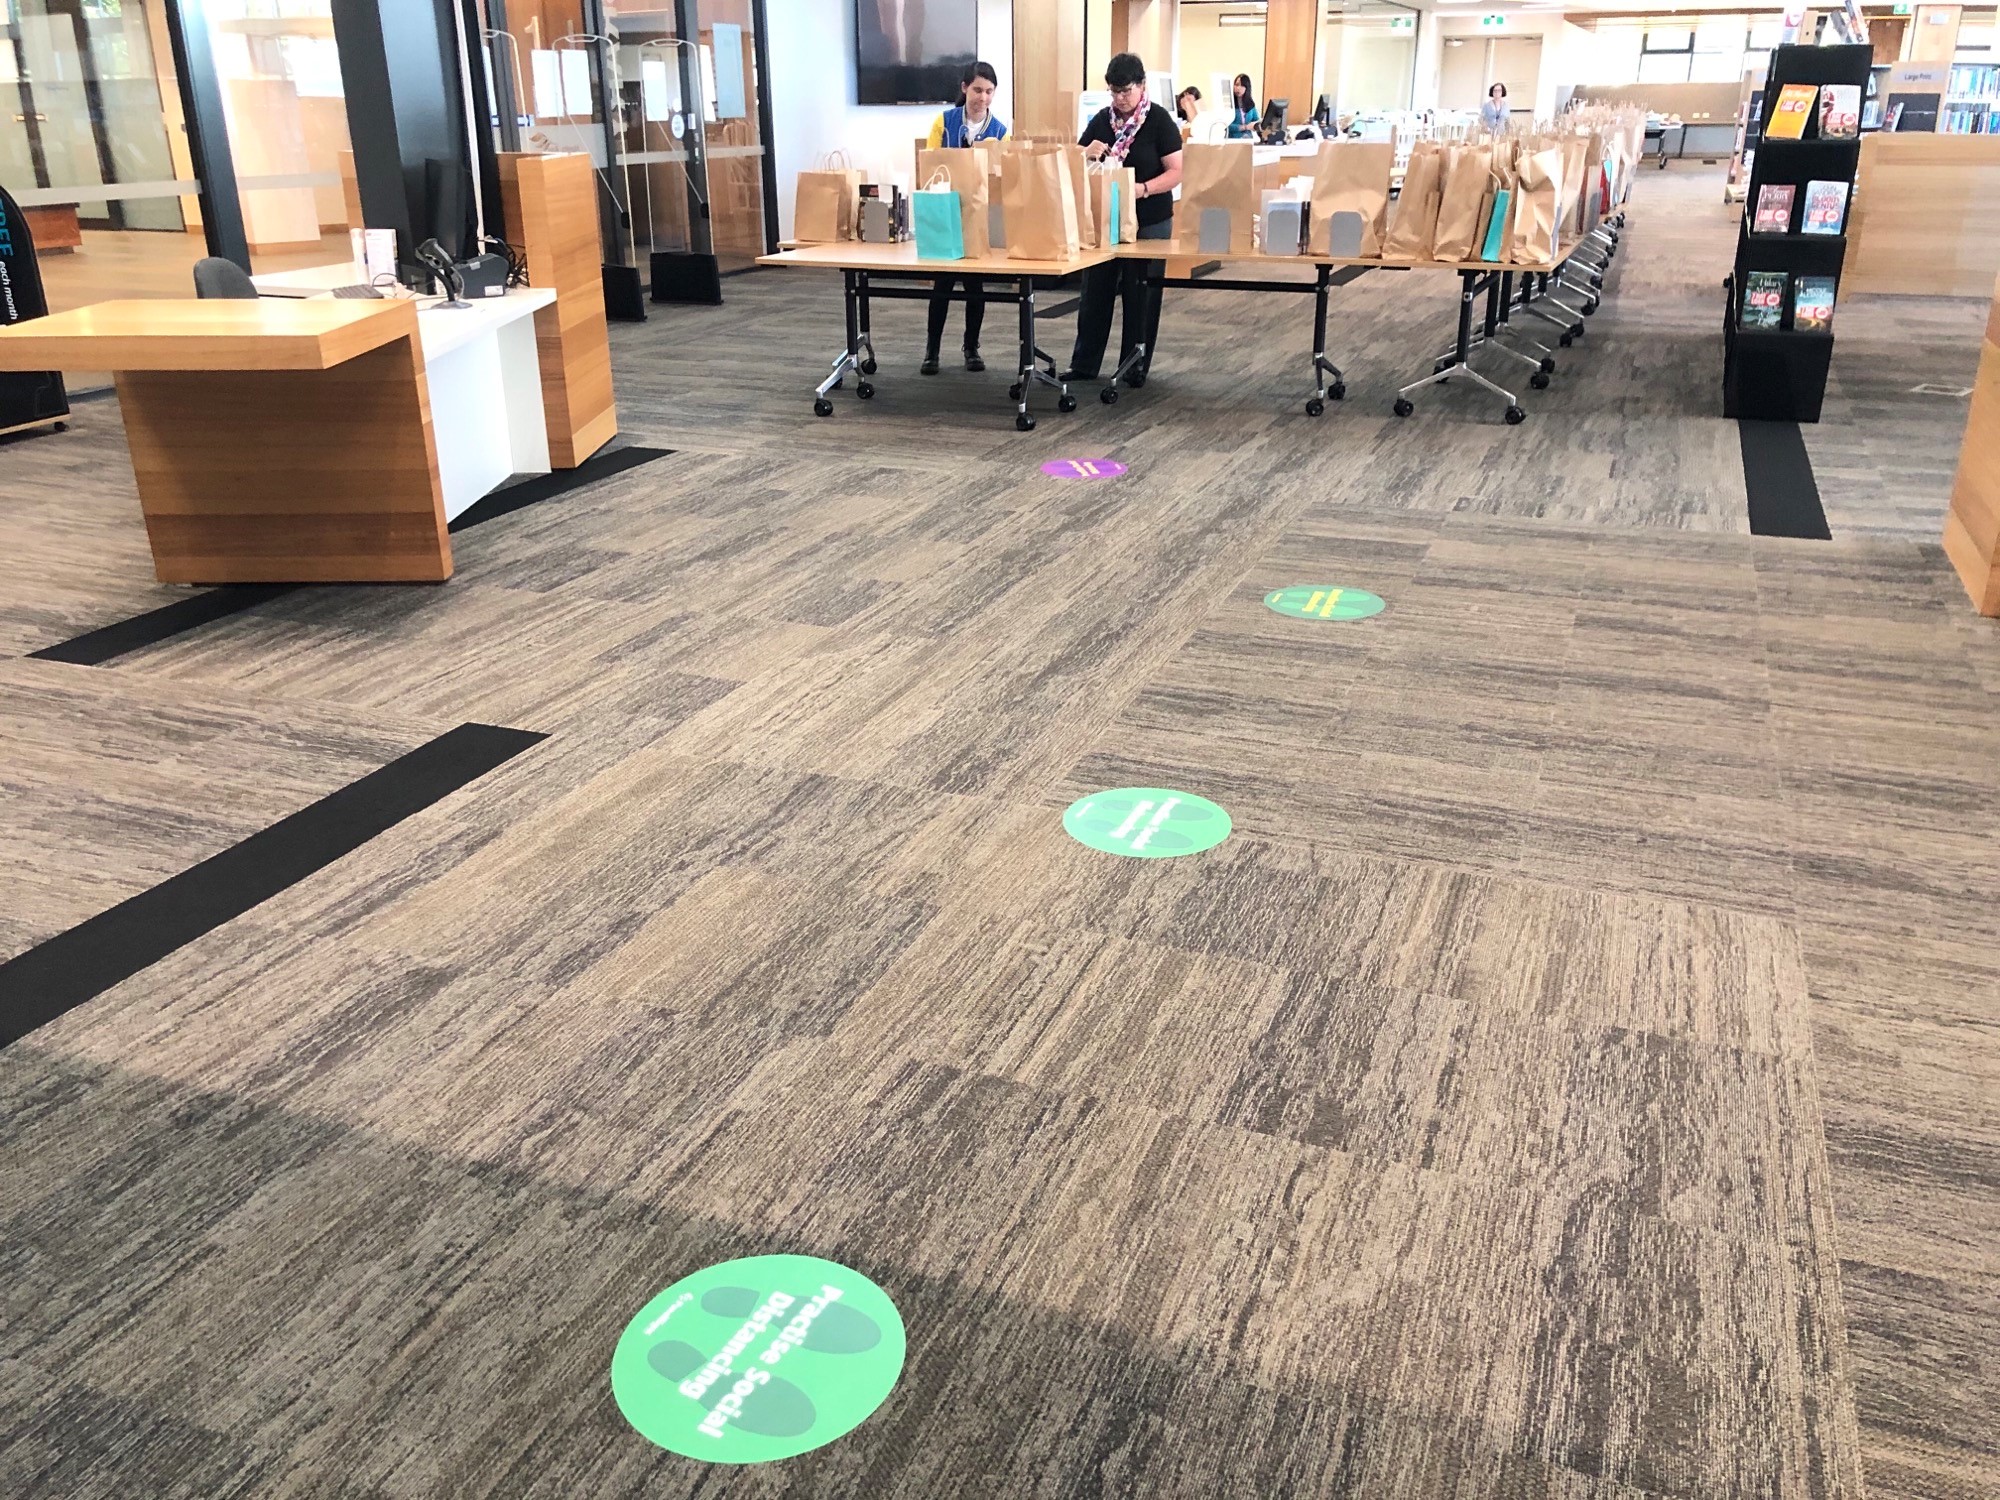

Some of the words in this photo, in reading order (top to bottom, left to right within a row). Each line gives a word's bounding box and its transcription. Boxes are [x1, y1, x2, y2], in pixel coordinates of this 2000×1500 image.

[0, 261, 11, 286] each
[4, 287, 18, 320] month
[678, 1290, 796, 1401] Distancing
[759, 1284, 845, 1365] Practise
[697, 1366, 771, 1439] Social
